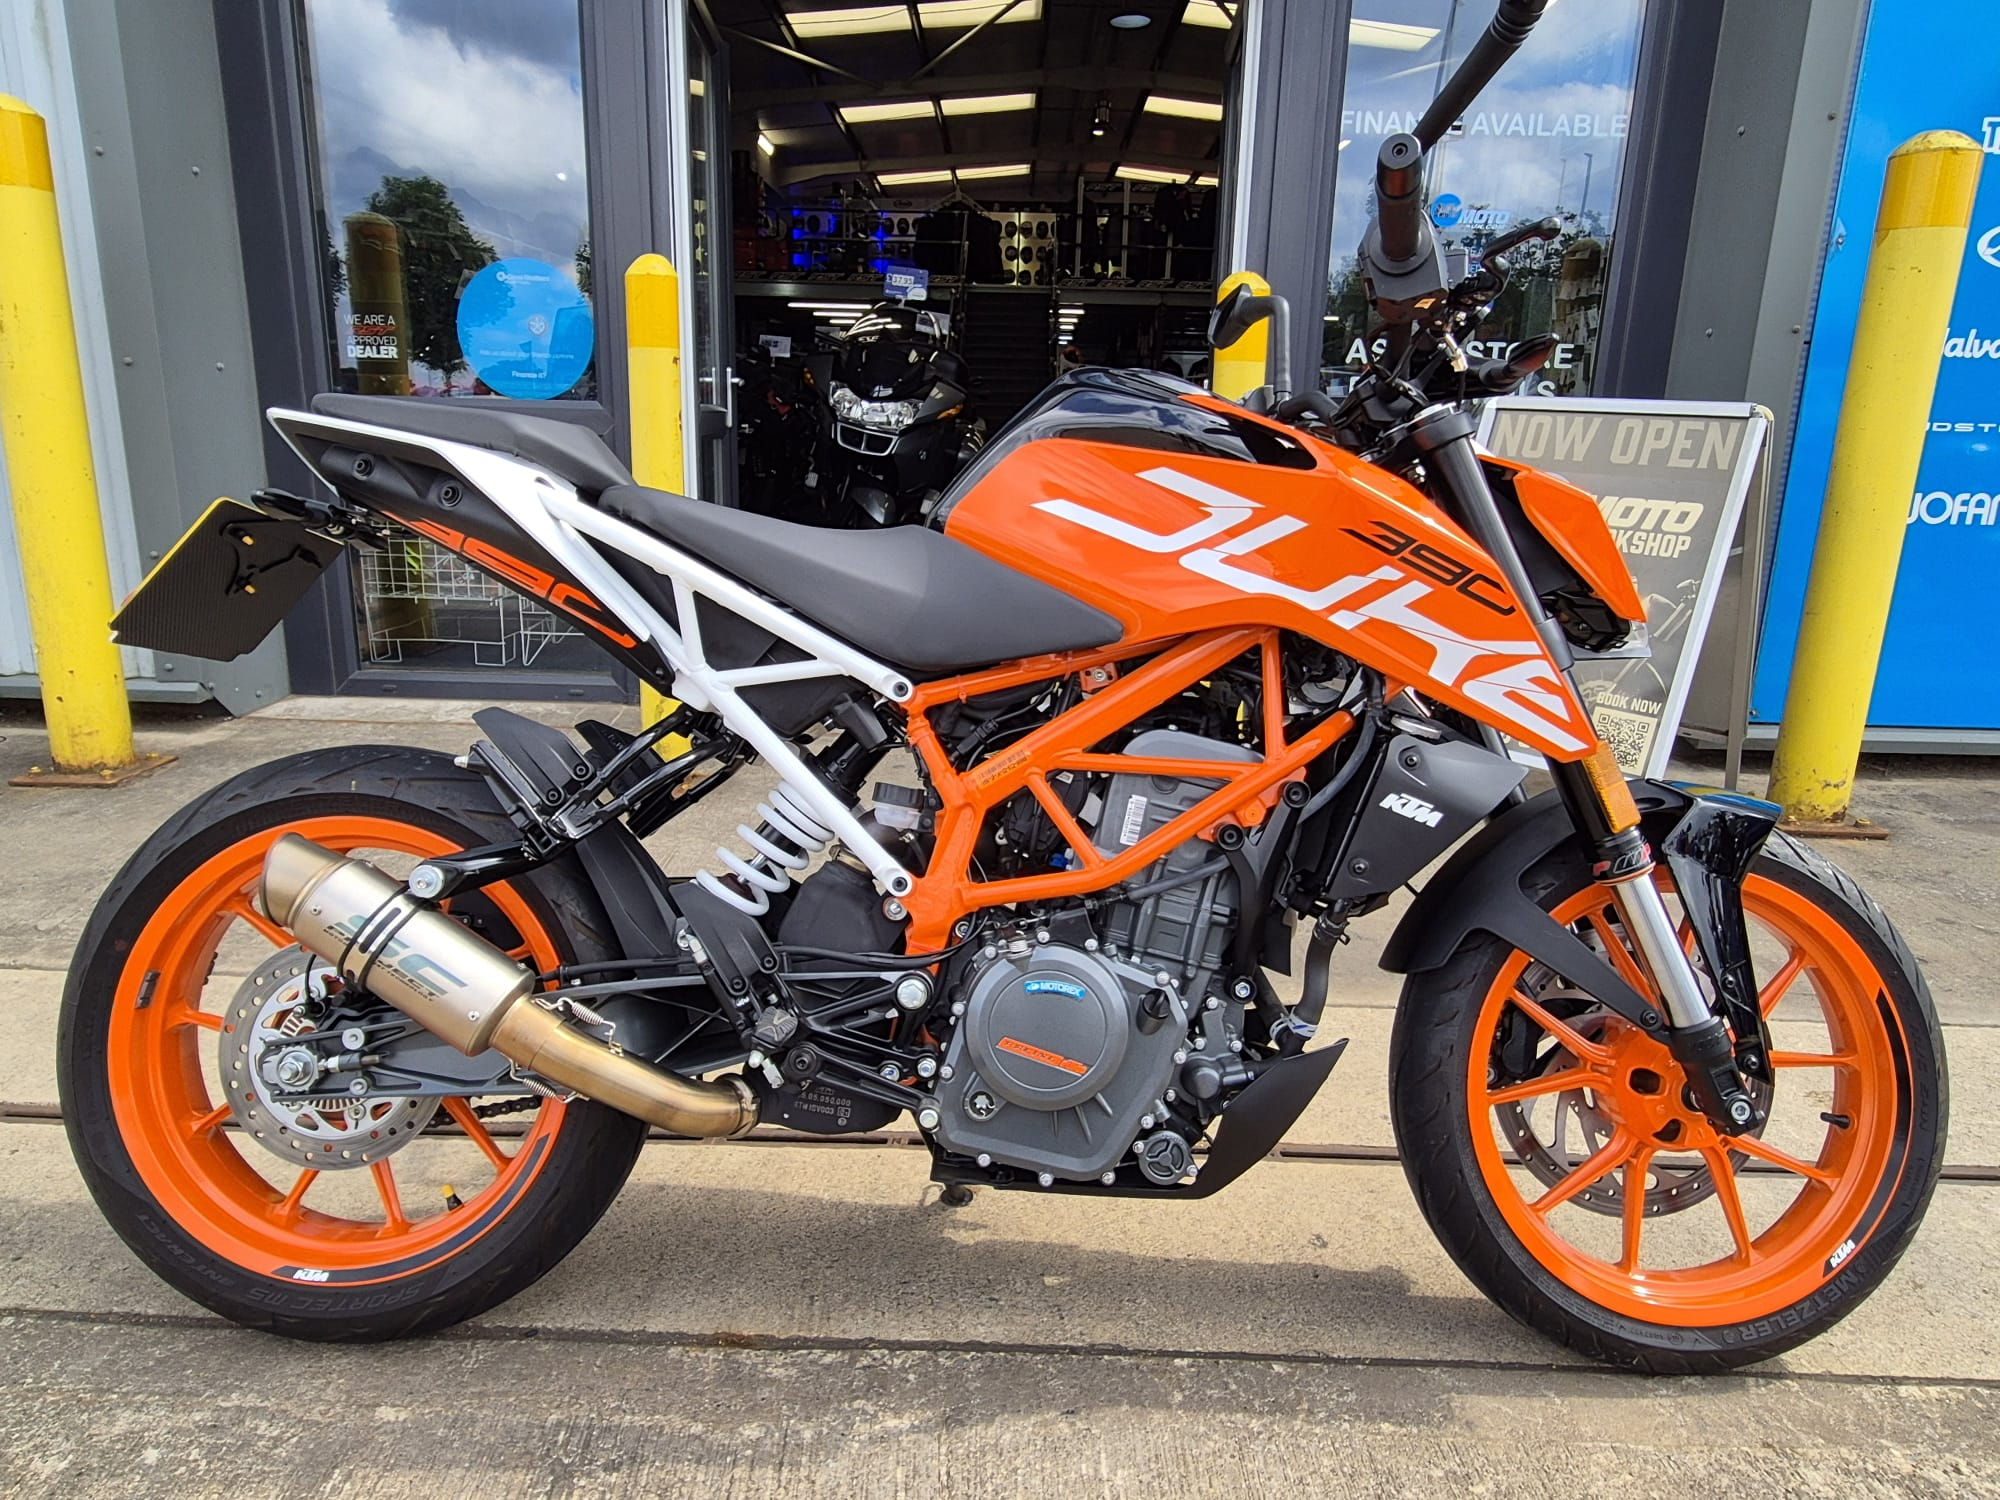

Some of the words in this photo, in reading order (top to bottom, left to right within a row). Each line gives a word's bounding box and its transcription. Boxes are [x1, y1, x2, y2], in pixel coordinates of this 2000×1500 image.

[1340, 110, 1463, 135] FINANE
[1470, 112, 1628, 138] AVAILABLE
[344, 314, 361, 325] WE
[363, 314, 386, 326] ARE
[387, 314, 396, 326] A
[346, 345, 399, 358] DEALER
[347, 335, 398, 346] APPROVED
[1493, 413, 1604, 462] NOW
[1609, 417, 1742, 471] OPEN
[1338, 520, 1516, 617] 390
[1596, 691, 1628, 709] BOOK
[1630, 698, 1663, 715] NOW
[1379, 793, 1444, 828] KTM
[1040, 981, 1081, 997] MOTOREX
[1829, 1239, 1856, 1269] KTM
[293, 1267, 330, 1283] KTM
[289, 1281, 425, 1313] SPORTEC
[1737, 1270, 1860, 1342] METZELER
